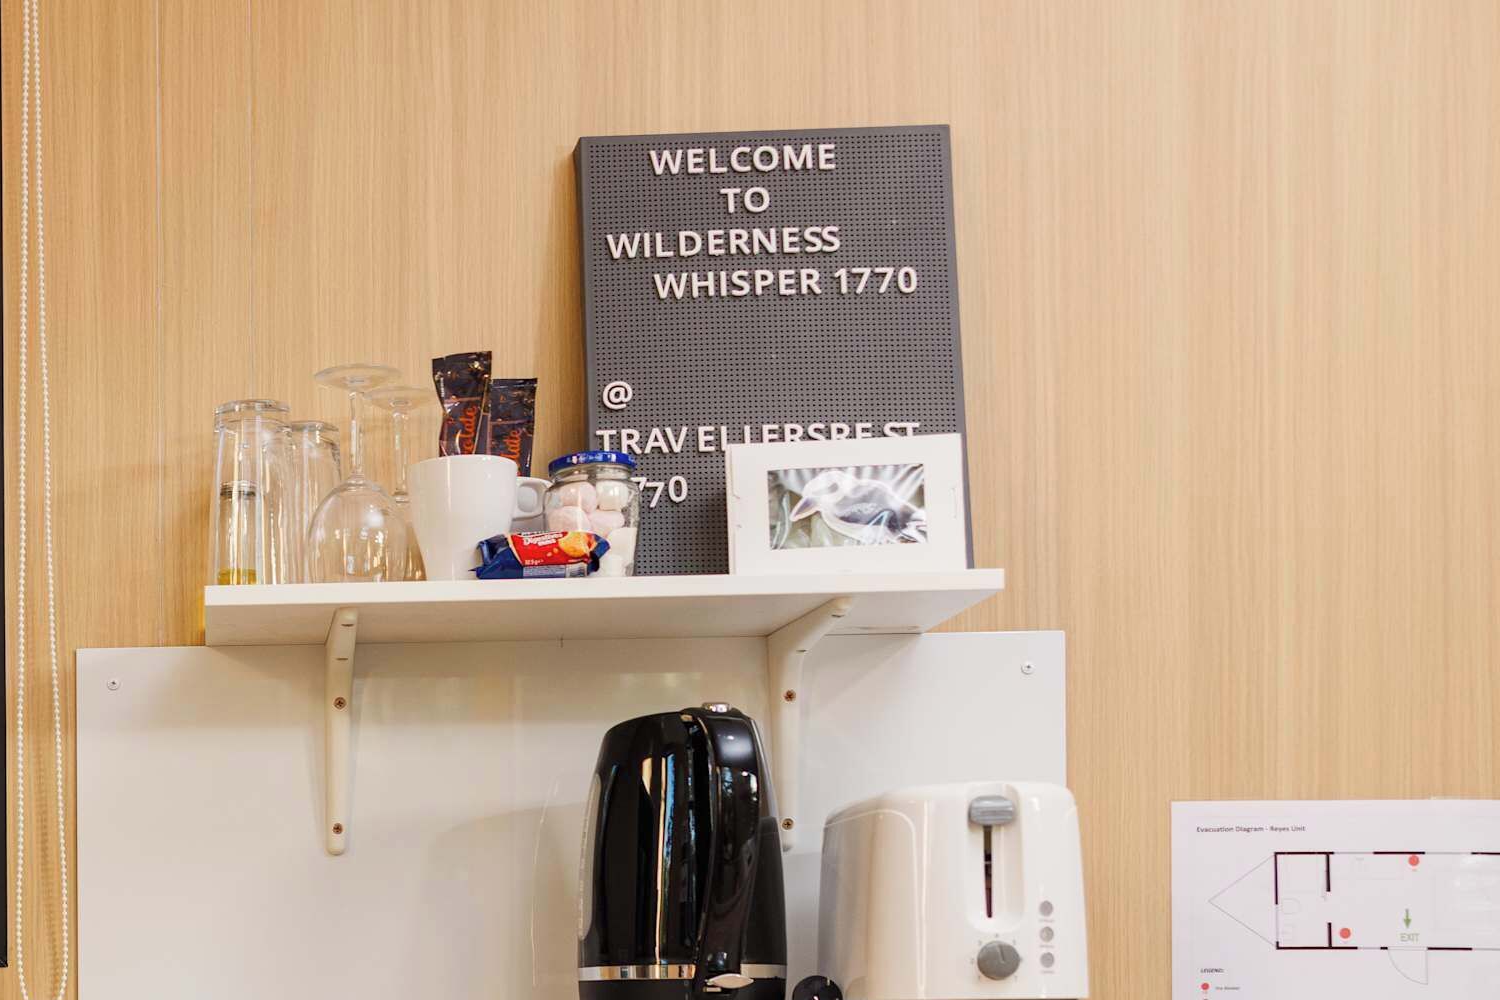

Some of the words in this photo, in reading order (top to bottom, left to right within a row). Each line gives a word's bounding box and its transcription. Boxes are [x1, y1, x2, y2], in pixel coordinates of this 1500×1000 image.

[649, 143, 837, 176] WELCOME
[720, 186, 771, 214] TO
[606, 225, 842, 260] WILDERNESS
[653, 268, 822, 300] WHISPER
[833, 266, 918, 295] 1770
[602, 380, 633, 411] @
[1235, 825, 1264, 833] Diagram
[1399, 932, 1420, 942] EXIT
